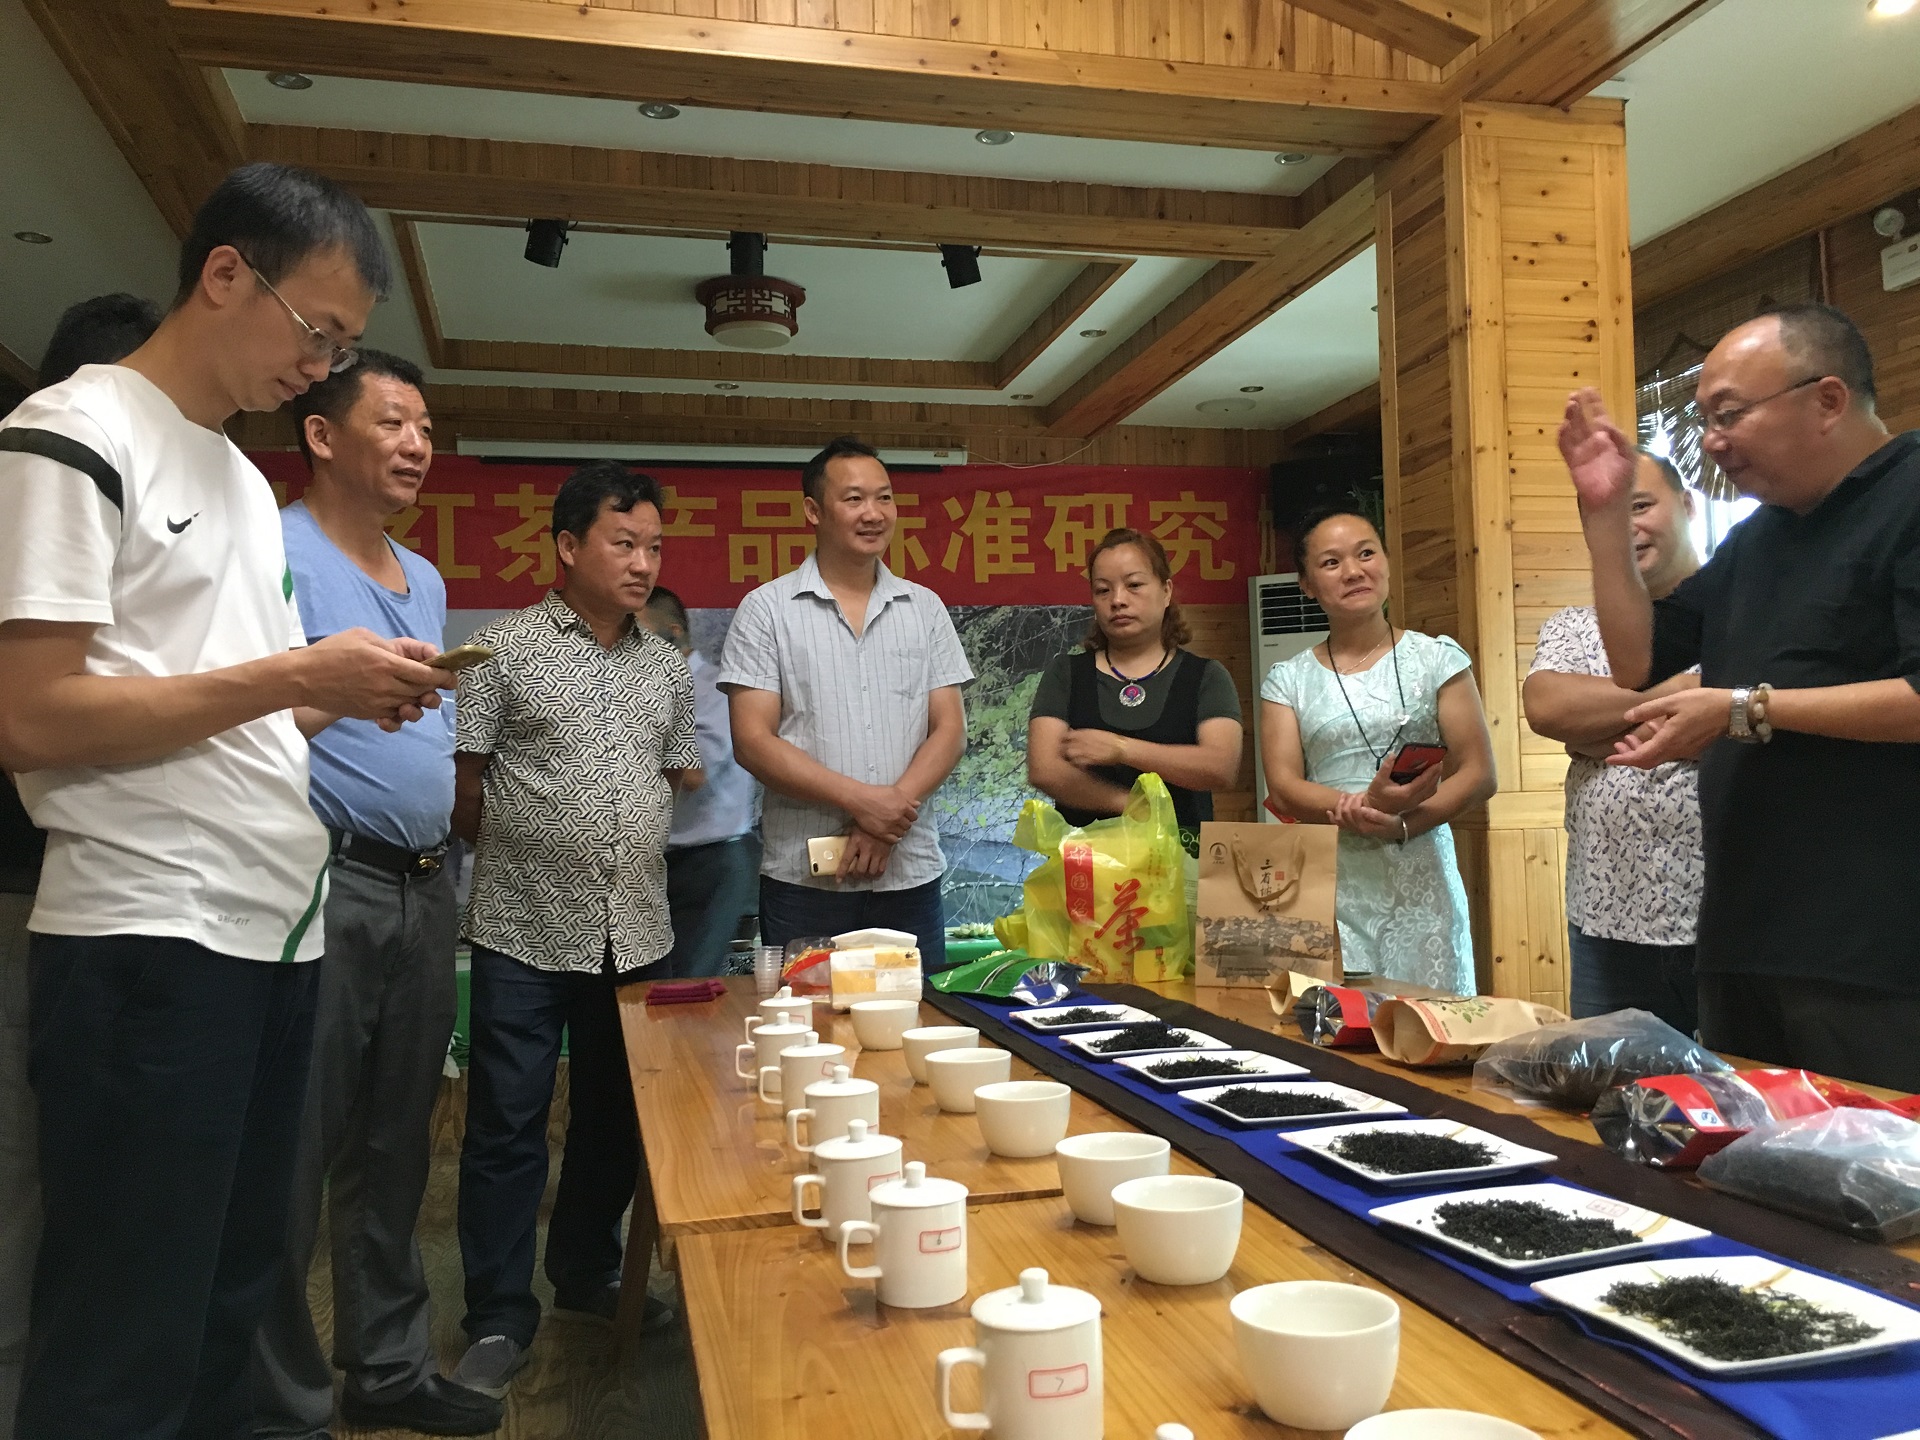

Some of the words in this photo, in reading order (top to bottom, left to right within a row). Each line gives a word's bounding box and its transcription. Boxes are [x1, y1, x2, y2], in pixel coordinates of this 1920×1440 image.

[270, 481, 1277, 586] 红茶品准研究
[1093, 878, 1150, 955] 茶
